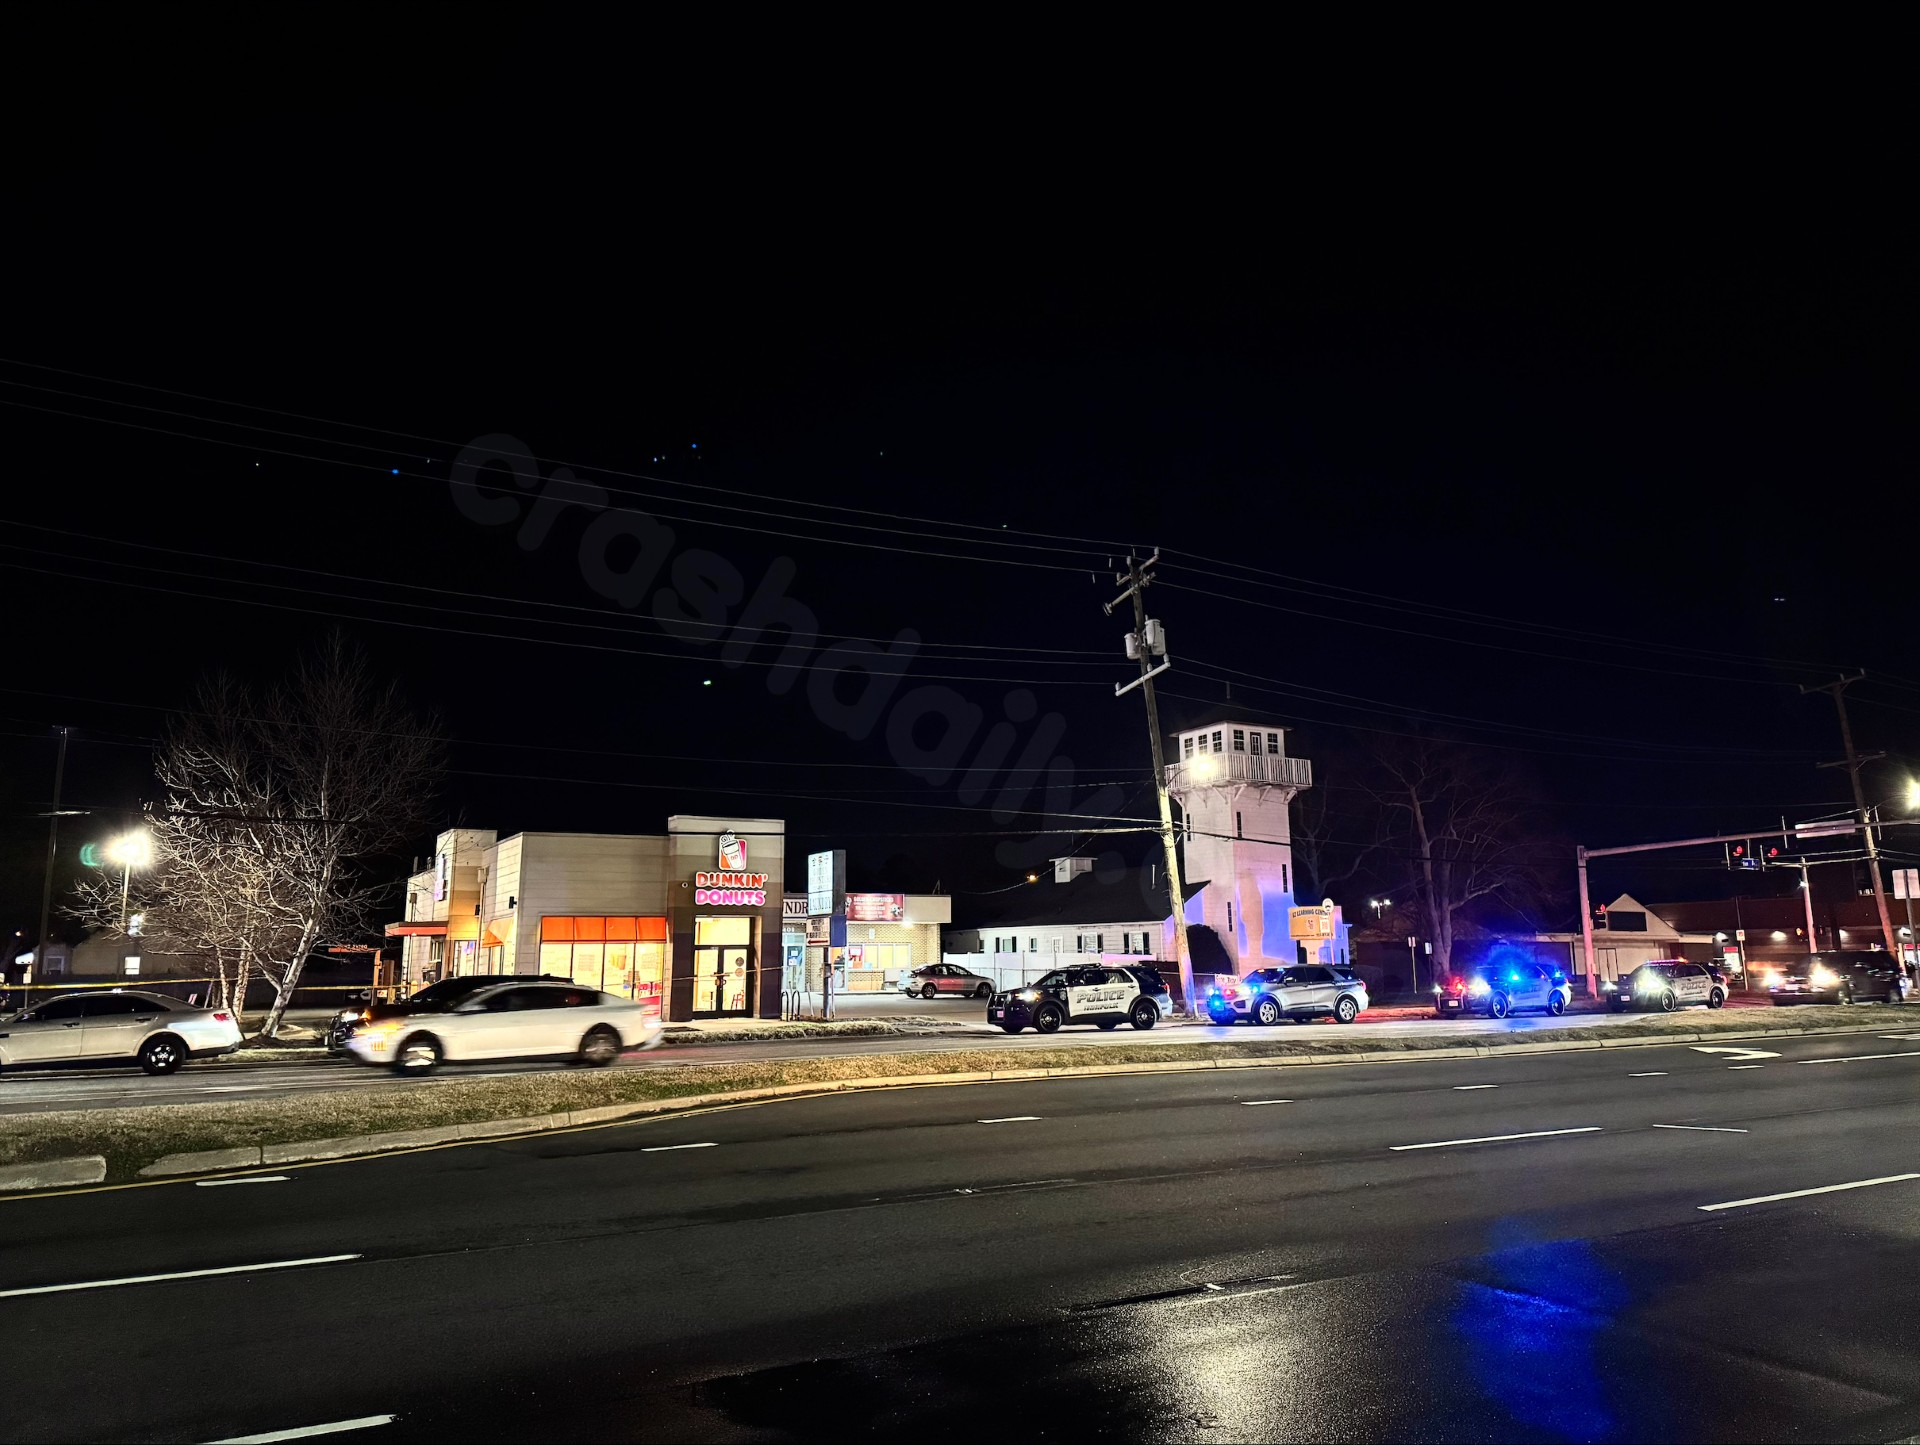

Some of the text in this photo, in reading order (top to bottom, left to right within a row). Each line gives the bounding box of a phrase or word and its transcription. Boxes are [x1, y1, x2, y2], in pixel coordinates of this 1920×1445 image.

[696, 872, 768, 888] DUNKIN'
[695, 889, 766, 906] DONUTS
[784, 901, 808, 913] NDR
[1077, 990, 1124, 1003] POLICE
